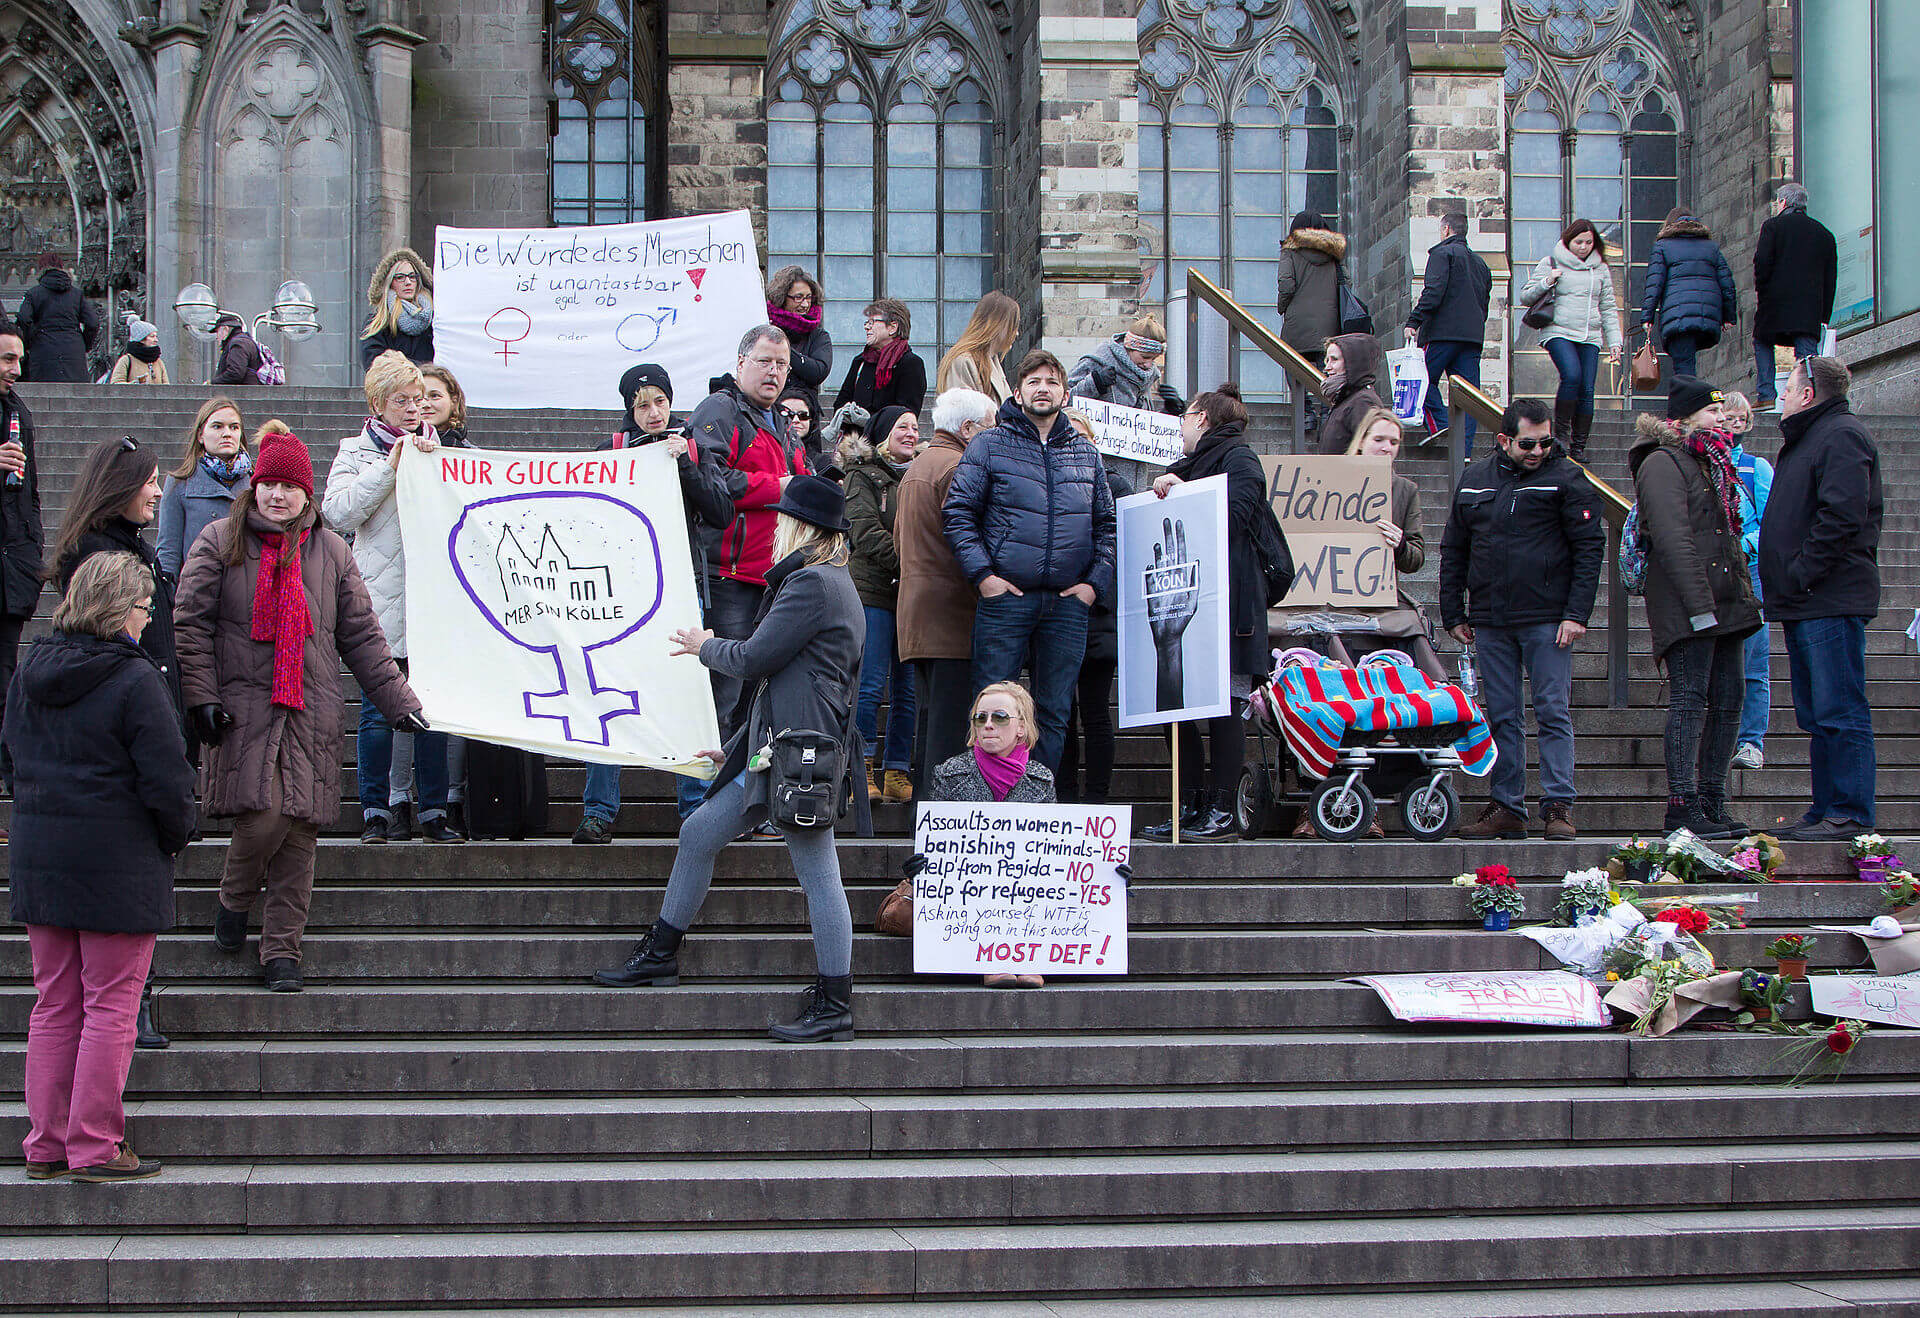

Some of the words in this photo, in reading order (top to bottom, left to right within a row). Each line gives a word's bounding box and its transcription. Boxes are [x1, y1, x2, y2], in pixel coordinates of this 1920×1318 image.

[440, 241, 489, 270] Die
[497, 233, 588, 266] Würde
[592, 237, 639, 263] des
[644, 225, 745, 267] Menschen
[516, 273, 538, 292] ist
[549, 273, 682, 291] unantastbar
[555, 292, 580, 311] egal
[595, 293, 617, 306] ob
[1095, 405, 1110, 425] will
[1112, 412, 1132, 428] mich
[1133, 413, 1147, 436] frei
[441, 457, 493, 485] NUR
[506, 459, 618, 485] GUCKEN
[1269, 464, 1388, 524] Hände
[1155, 572, 1184, 592] KÖLN
[505, 604, 532, 626] MER
[535, 601, 561, 619] SIN
[566, 605, 624, 621] KÖLLE
[917, 809, 989, 832] Assaults
[992, 818, 1012, 832] on
[1085, 815, 1117, 839] NO
[924, 832, 1016, 860] banishing
[1101, 840, 1128, 864] YES
[956, 857, 992, 881] from
[997, 856, 1051, 880] Pegida
[1066, 860, 1095, 883] NO
[916, 878, 955, 905] Help
[960, 879, 989, 905] for
[992, 880, 1066, 905] refugees
[1079, 884, 1112, 906] YES
[917, 904, 968, 927] Asking
[975, 904, 1038, 926] yourself
[1044, 906, 1079, 922] WTF
[1079, 906, 1090, 920] is
[942, 922, 981, 942] going
[985, 925, 1001, 935] on
[1006, 922, 1017, 937] in
[1021, 922, 1046, 937] this
[976, 942, 1042, 963] MOST
[1049, 942, 1092, 965] DEF
[1450, 979, 1585, 1010] FRAUEN
